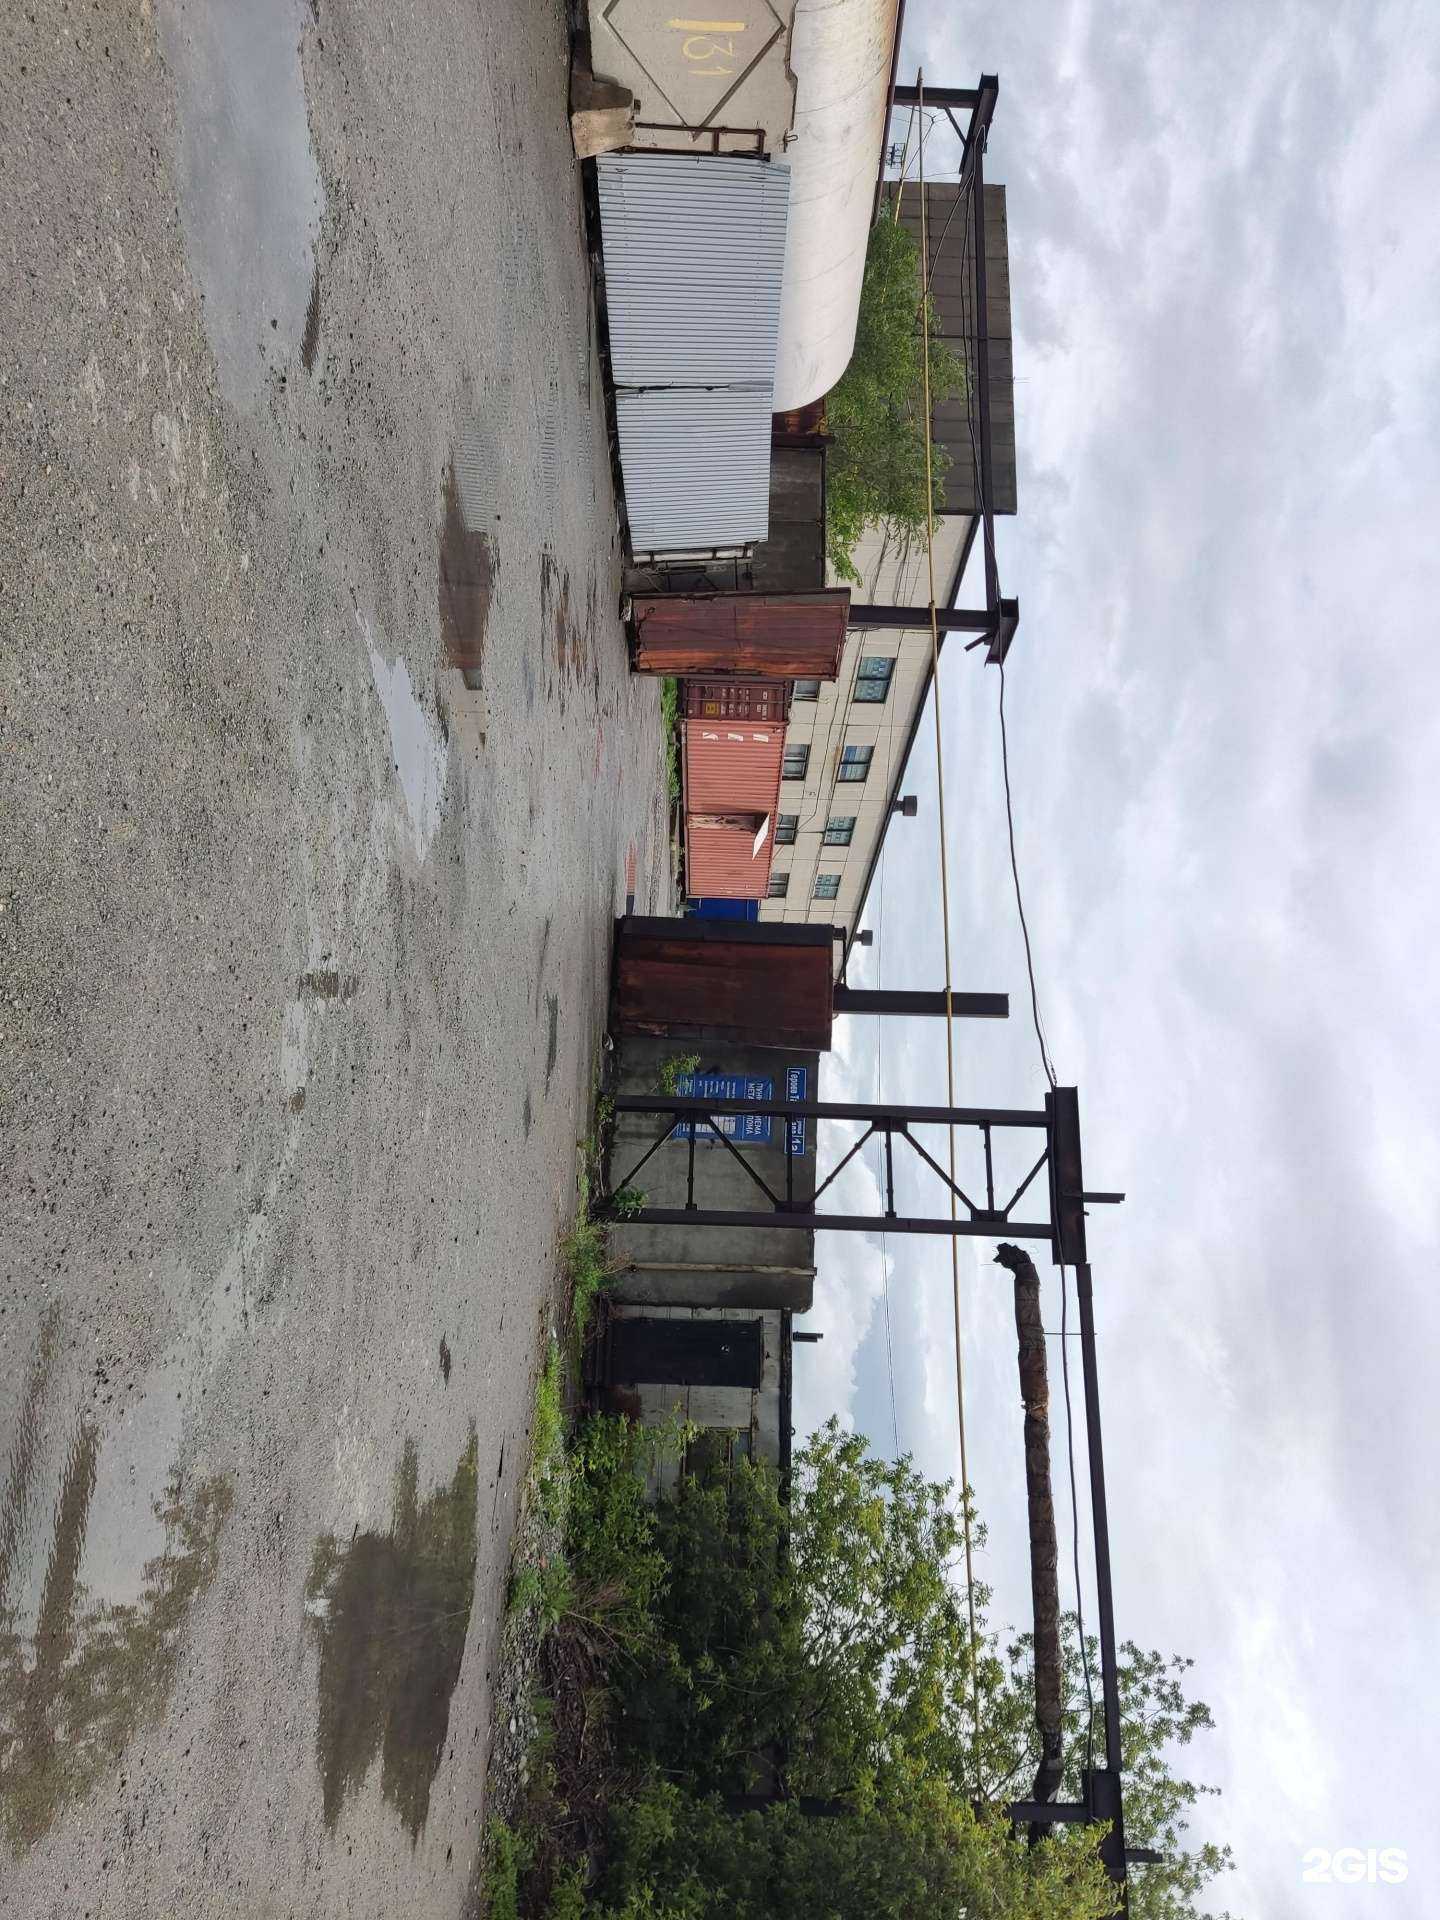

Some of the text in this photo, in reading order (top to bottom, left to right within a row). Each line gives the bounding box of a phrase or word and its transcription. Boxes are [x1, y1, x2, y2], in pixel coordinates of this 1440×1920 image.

[789, 1070, 800, 1094] Героев
[754, 1083, 763, 1135] ПУНК ИЕМА
